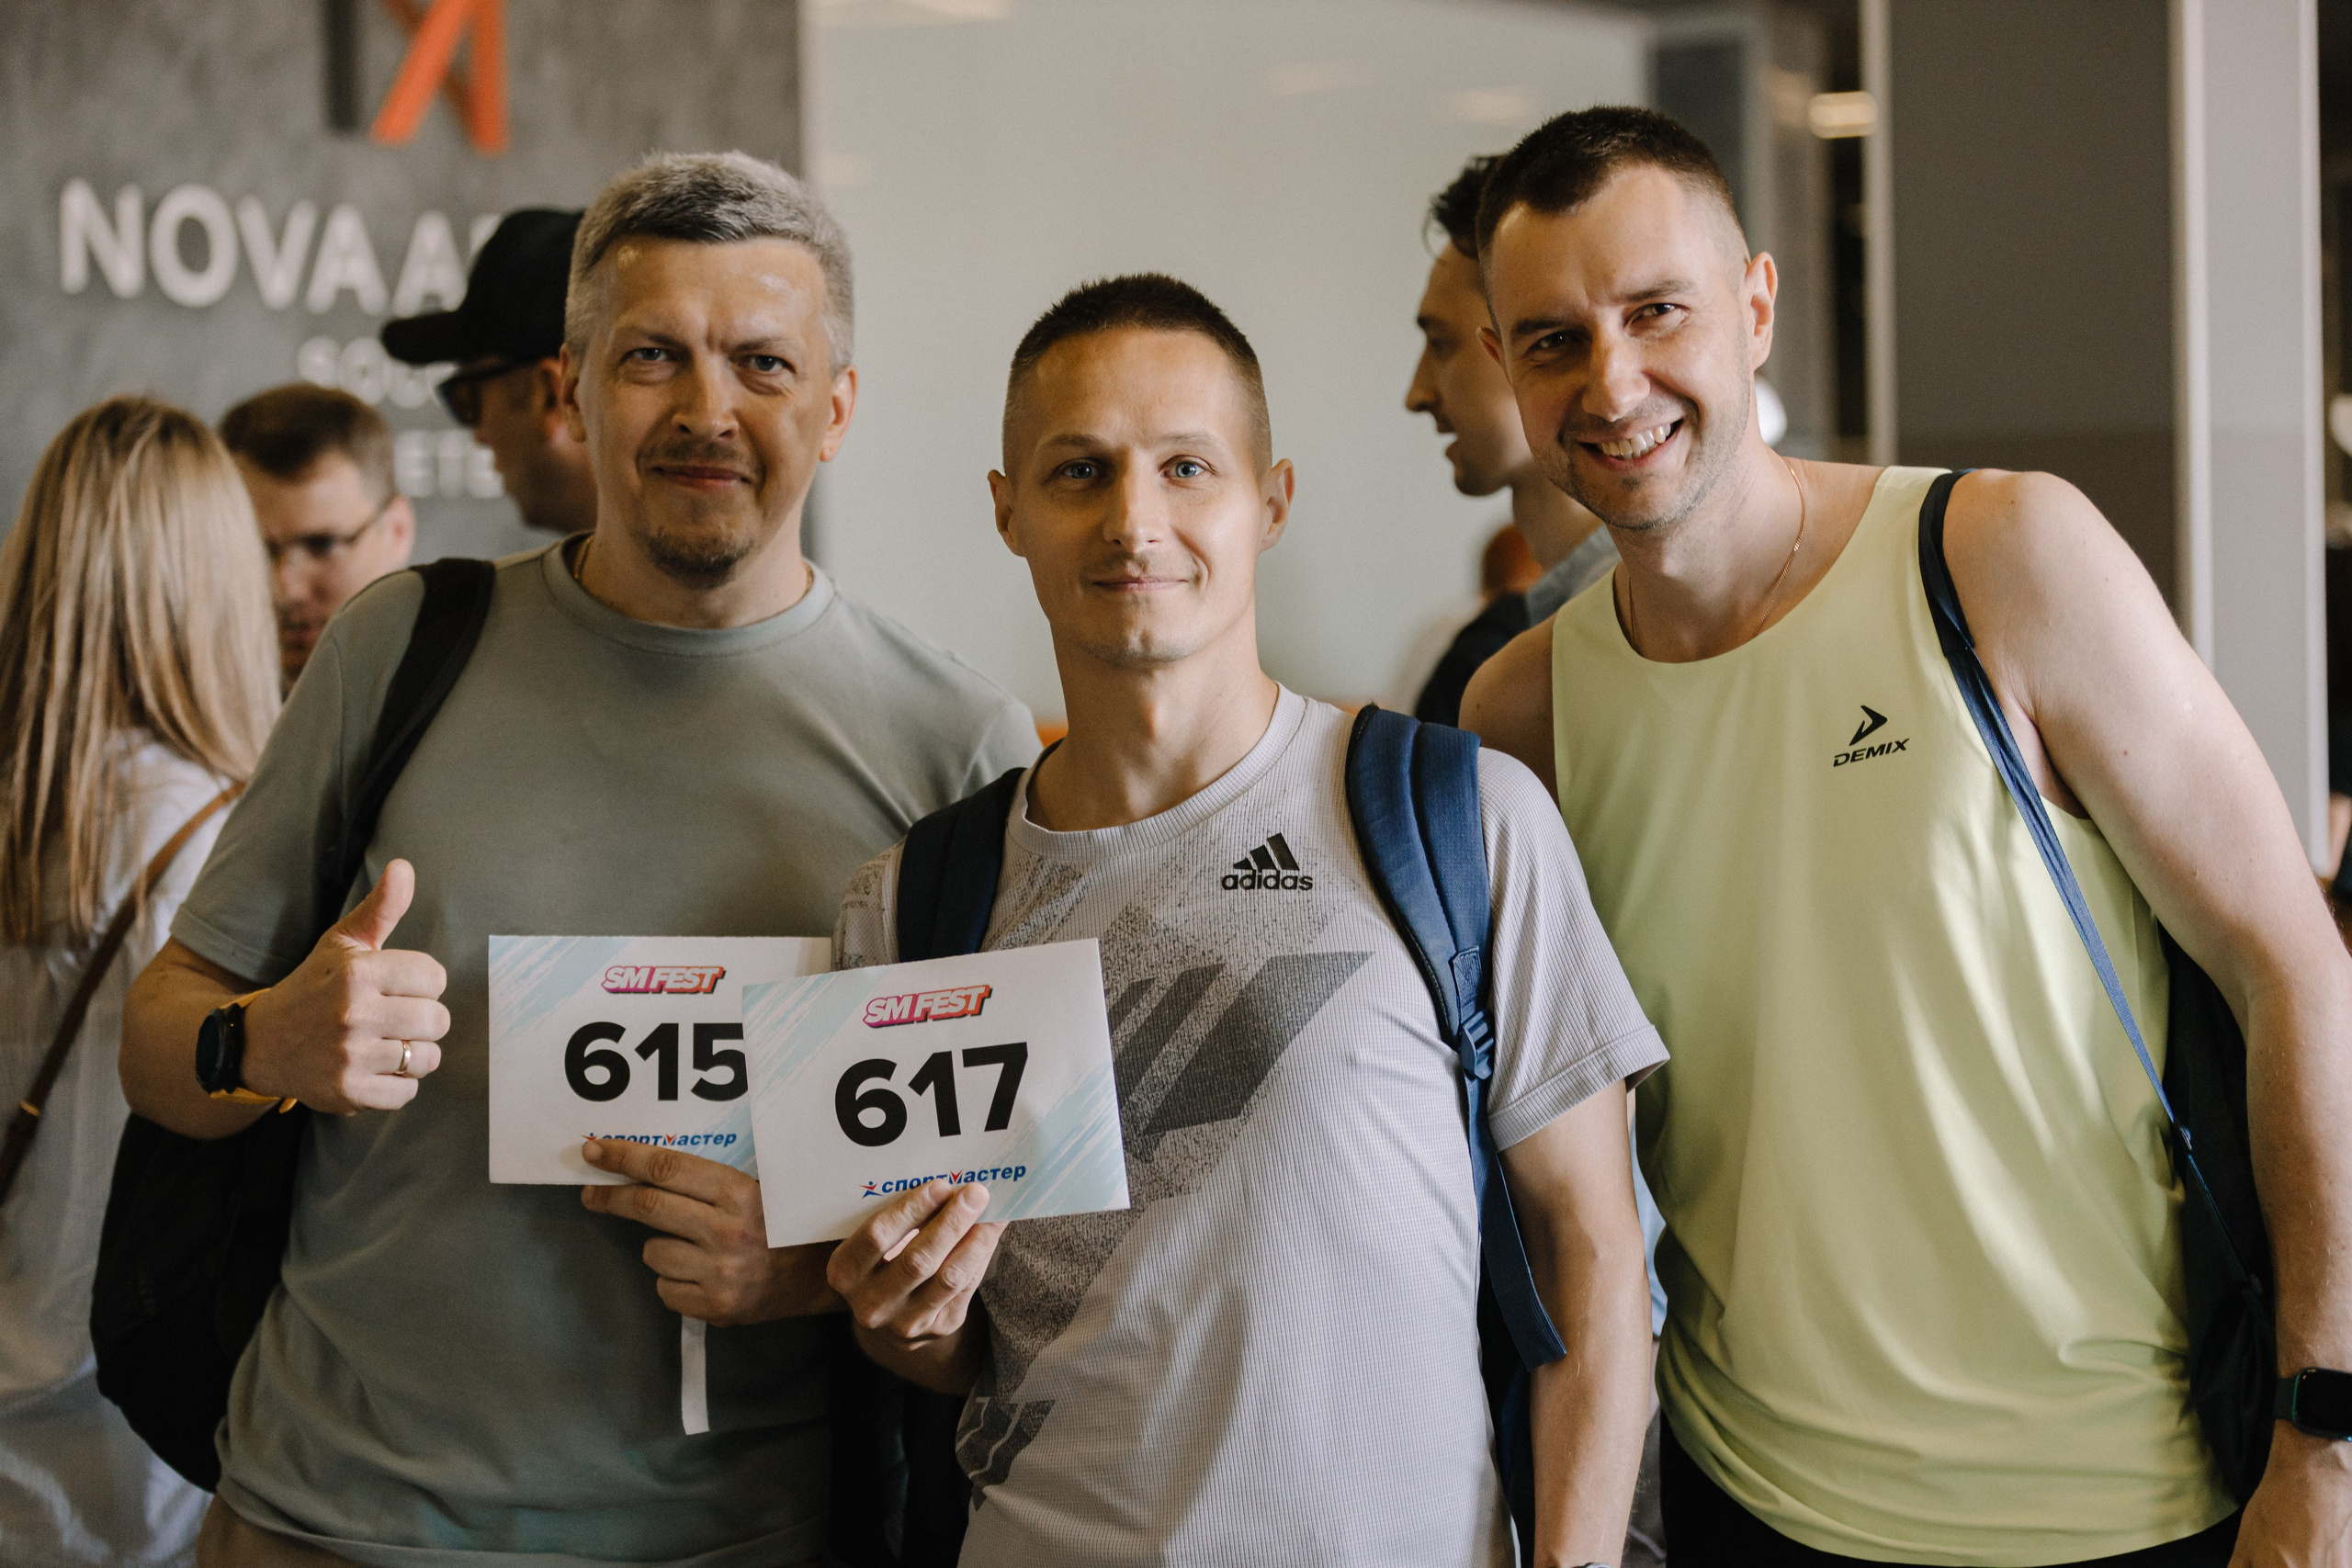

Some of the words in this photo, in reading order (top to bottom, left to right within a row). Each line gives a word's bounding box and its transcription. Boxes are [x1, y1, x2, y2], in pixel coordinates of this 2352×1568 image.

[1833, 738, 1910, 767] DEMIX
[1221, 869, 1313, 890] adidas
[601, 965, 651, 993] SM
[649, 965, 724, 993] FEST
[863, 994, 915, 1028] SM
[912, 984, 992, 1022] FEST
[565, 1021, 748, 1101] 615
[834, 1042, 1028, 1146] 617
